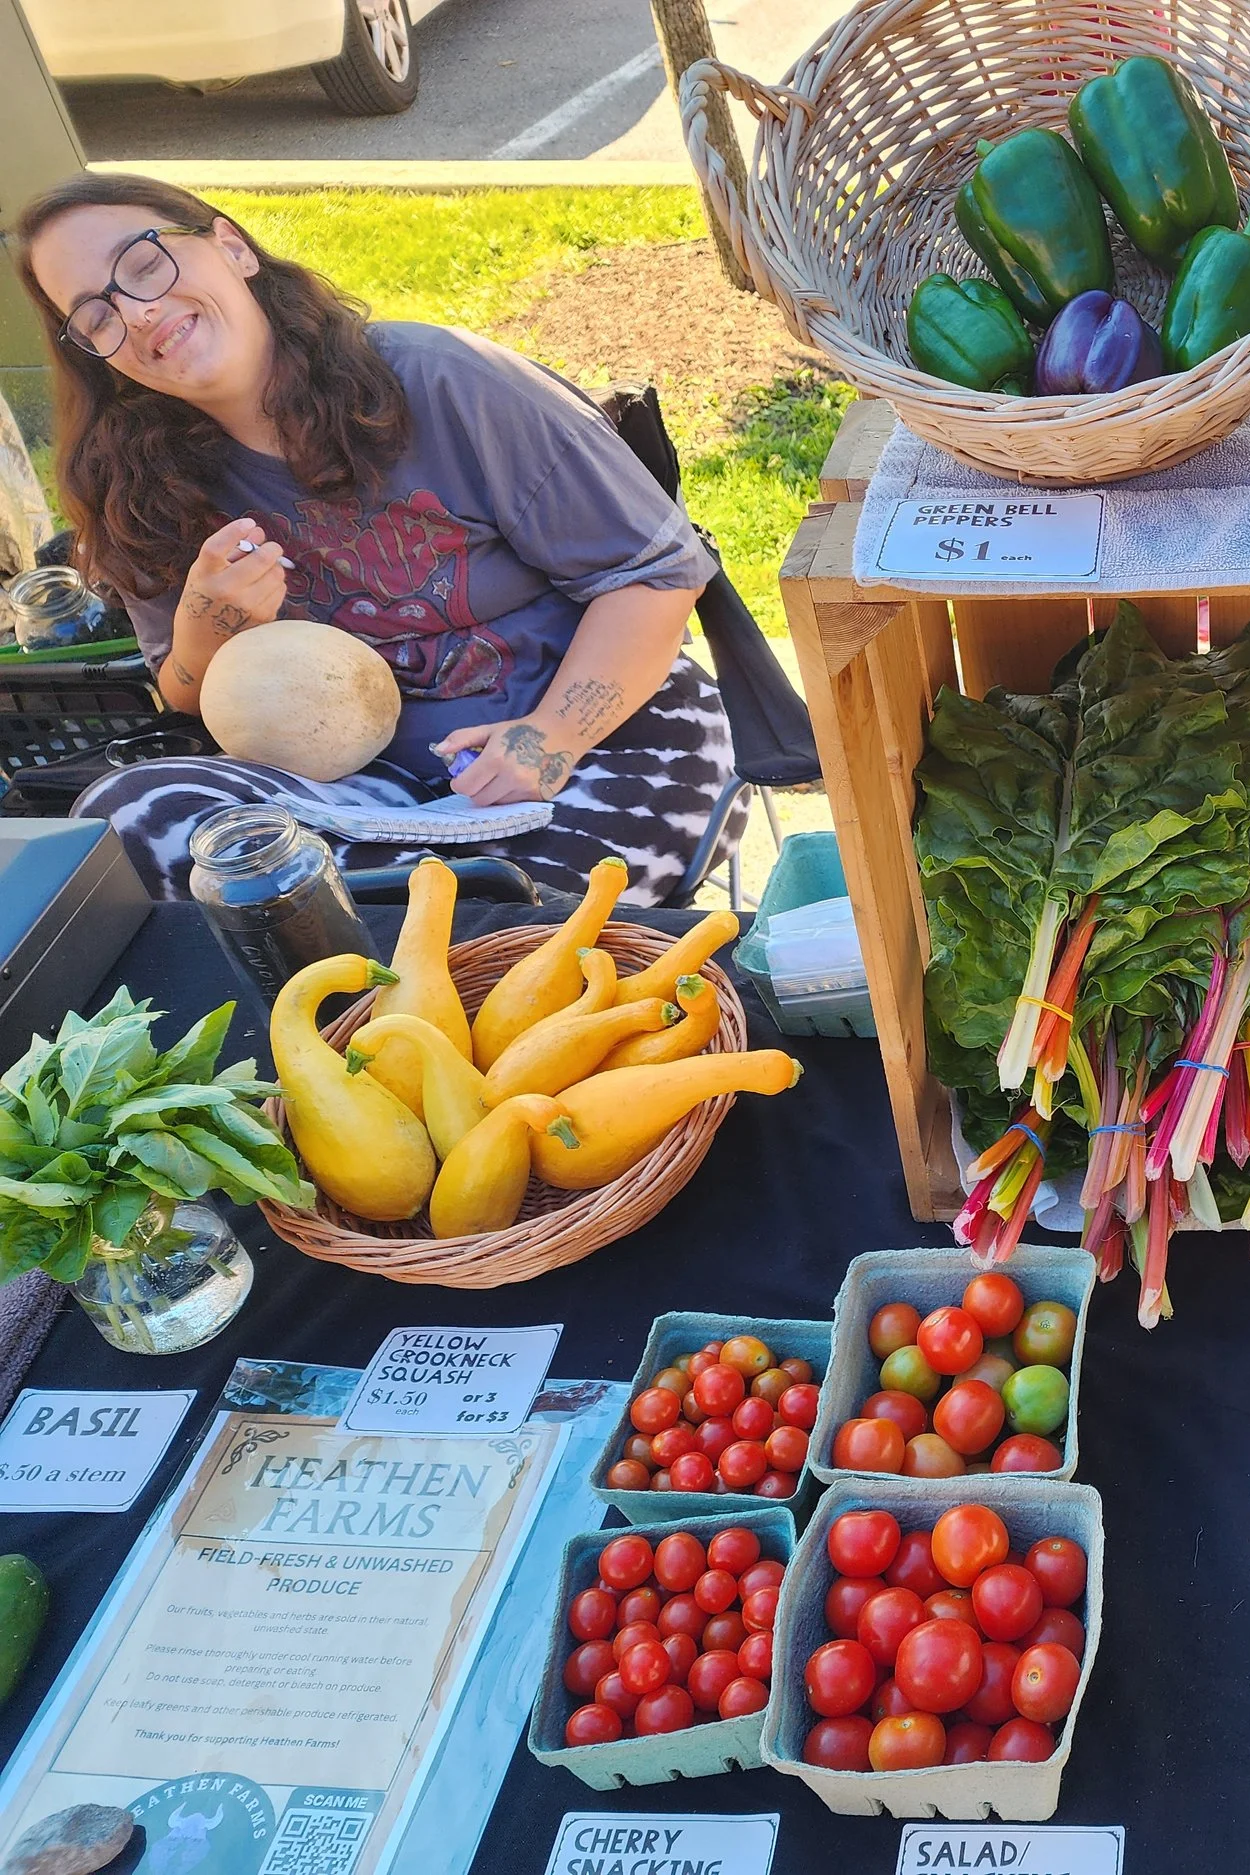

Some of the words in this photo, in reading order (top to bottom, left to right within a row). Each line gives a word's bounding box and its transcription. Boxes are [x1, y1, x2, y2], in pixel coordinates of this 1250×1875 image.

[918, 504, 994, 514] GREEN
[1005, 504, 1058, 515] BELL
[913, 516, 1013, 527] PEPPERS
[934, 538, 992, 562] $1
[1001, 554, 1032, 562] each
[401, 1334, 488, 1350] YELLOW
[389, 1349, 518, 1368] CROOKNECK
[378, 1366, 473, 1384] SQUASH
[367, 1388, 428, 1406] $1.50
[462, 1394, 483, 1402] or
[485, 1392, 497, 1403] 3
[22, 1406, 142, 1436] BASIL
[395, 1408, 420, 1416] each
[456, 1410, 484, 1422] for
[486, 1411, 510, 1423] $3
[45, 1470, 60, 1482] a
[65, 1467, 126, 1482] stem
[250, 1455, 492, 1498] HEATHEN
[260, 1496, 442, 1538] FARMS
[197, 1547, 322, 1570] FIELD-FRESH
[324, 1555, 338, 1570] &
[342, 1554, 454, 1574] UNWASHED
[266, 1578, 363, 1596] PRODUCE
[167, 1604, 184, 1614] Our
[186, 1606, 214, 1617] fruits,
[218, 1609, 268, 1620] vegetables
[270, 1611, 288, 1620] and
[290, 1612, 316, 1622] herbs
[318, 1614, 332, 1622] are
[336, 1614, 357, 1624] sold
[358, 1614, 367, 1624] in
[368, 1615, 390, 1624] their
[394, 1616, 430, 1626] natural,
[253, 1625, 300, 1634] unwashed
[146, 1644, 176, 1654] Please
[180, 1646, 201, 1656] rinse
[204, 1649, 260, 1661] thoroughly
[262, 1652, 288, 1662] under
[290, 1652, 310, 1662] cool
[312, 1654, 350, 1664] running
[350, 1656, 378, 1664] water
[380, 1655, 412, 1666] before
[224, 1664, 272, 1676] preparing
[274, 1668, 284, 1676] or
[146, 1672, 160, 1681] Do
[163, 1674, 180, 1682] not
[182, 1676, 199, 1685] use
[228, 1679, 278, 1689] detergent
[290, 1680, 323, 1690] bleach
[339, 1684, 382, 1693] produce.
[104, 1698, 128, 1708] Keep
[130, 1698, 154, 1711] leafy
[156, 1703, 190, 1712] greens
[191, 1704, 210, 1714] and
[212, 1706, 240, 1716] other
[240, 1707, 291, 1718] perishable
[293, 1710, 336, 1720] produce
[337, 1711, 398, 1723] refrigerated.
[134, 1729, 164, 1740] Thank
[167, 1733, 186, 1743] you
[188, 1733, 202, 1742] for
[204, 1734, 258, 1746] supporting
[260, 1736, 302, 1748] Heathen
[304, 1738, 340, 1748] Farms!
[131, 1778, 226, 1819] EATHEN
[228, 1783, 267, 1840] FARMS
[303, 1794, 346, 1807] SCAN
[346, 1796, 368, 1809] ME
[574, 1828, 684, 1854] CHERRY
[916, 1840, 1031, 1868] SALAD/
[566, 1858, 722, 1875] SNACKING
